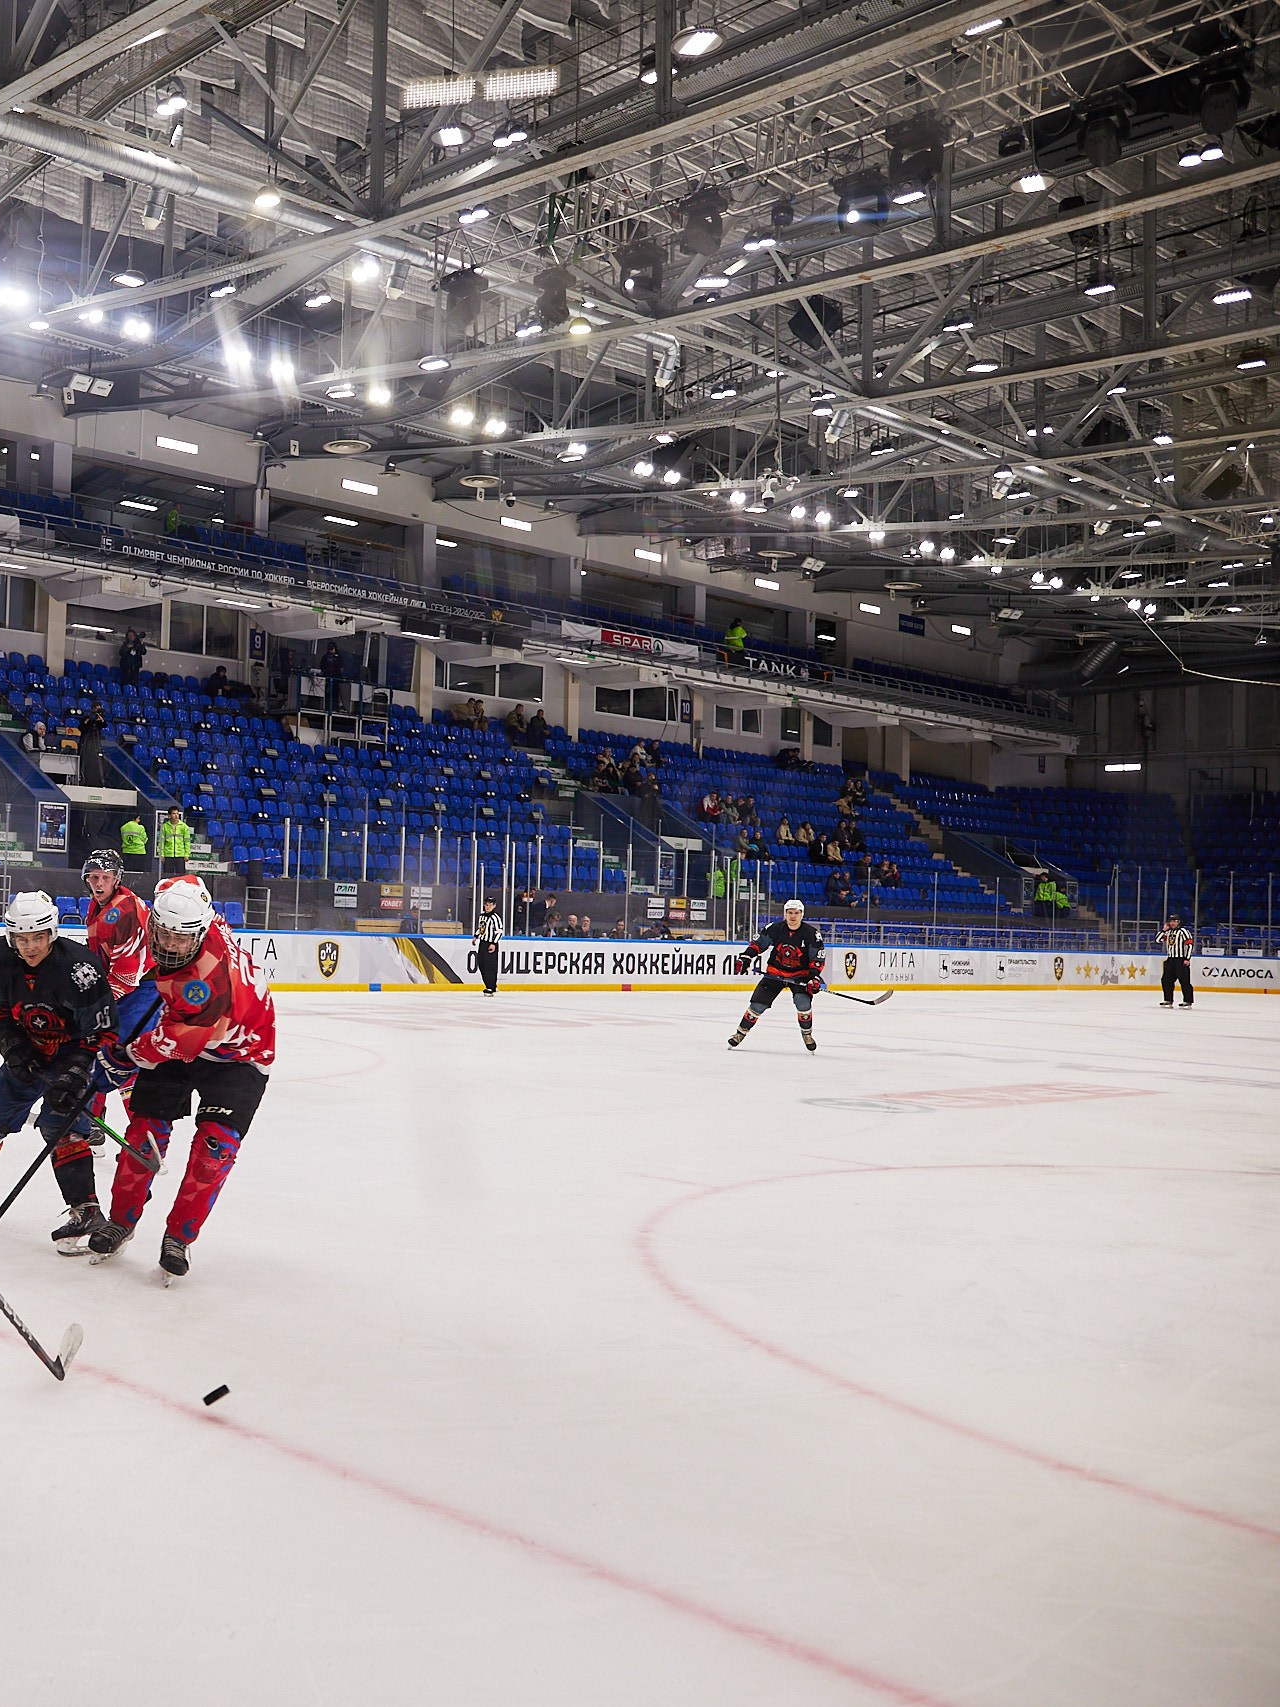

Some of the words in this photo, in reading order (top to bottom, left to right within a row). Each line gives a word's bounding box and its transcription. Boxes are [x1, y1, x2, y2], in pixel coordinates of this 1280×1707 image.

[66, 392, 72, 400] 8
[122, 546, 165, 562] OLIMPBET
[165, 553, 216, 571] ЧЕМПИОНАТ
[218, 562, 249, 577] РОССИИ
[251, 570, 263, 580] ПО
[264, 572, 296, 586] ХОККЕЮ
[306, 577, 367, 599] ВСЕРОССИЙСКАЯ
[254, 634, 262, 648] 9
[612, 634, 652, 650] SPAR
[744, 656, 796, 678] TANK
[682, 702, 690, 714] 10
[381, 900, 402, 908] FONBET
[466, 951, 604, 975] ОИЦЕРСКАЯ
[612, 948, 716, 976] ХОККЕЙНАЯ
[878, 952, 916, 968] ЛИГА
[951, 958, 970, 966] НИЖНИЙ
[880, 974, 914, 982] СИЛЬНЫХ
[951, 968, 974, 976] НОВГОРОД
[93, 1005, 111, 1031] 93
[198, 1106, 234, 1116] CCM
